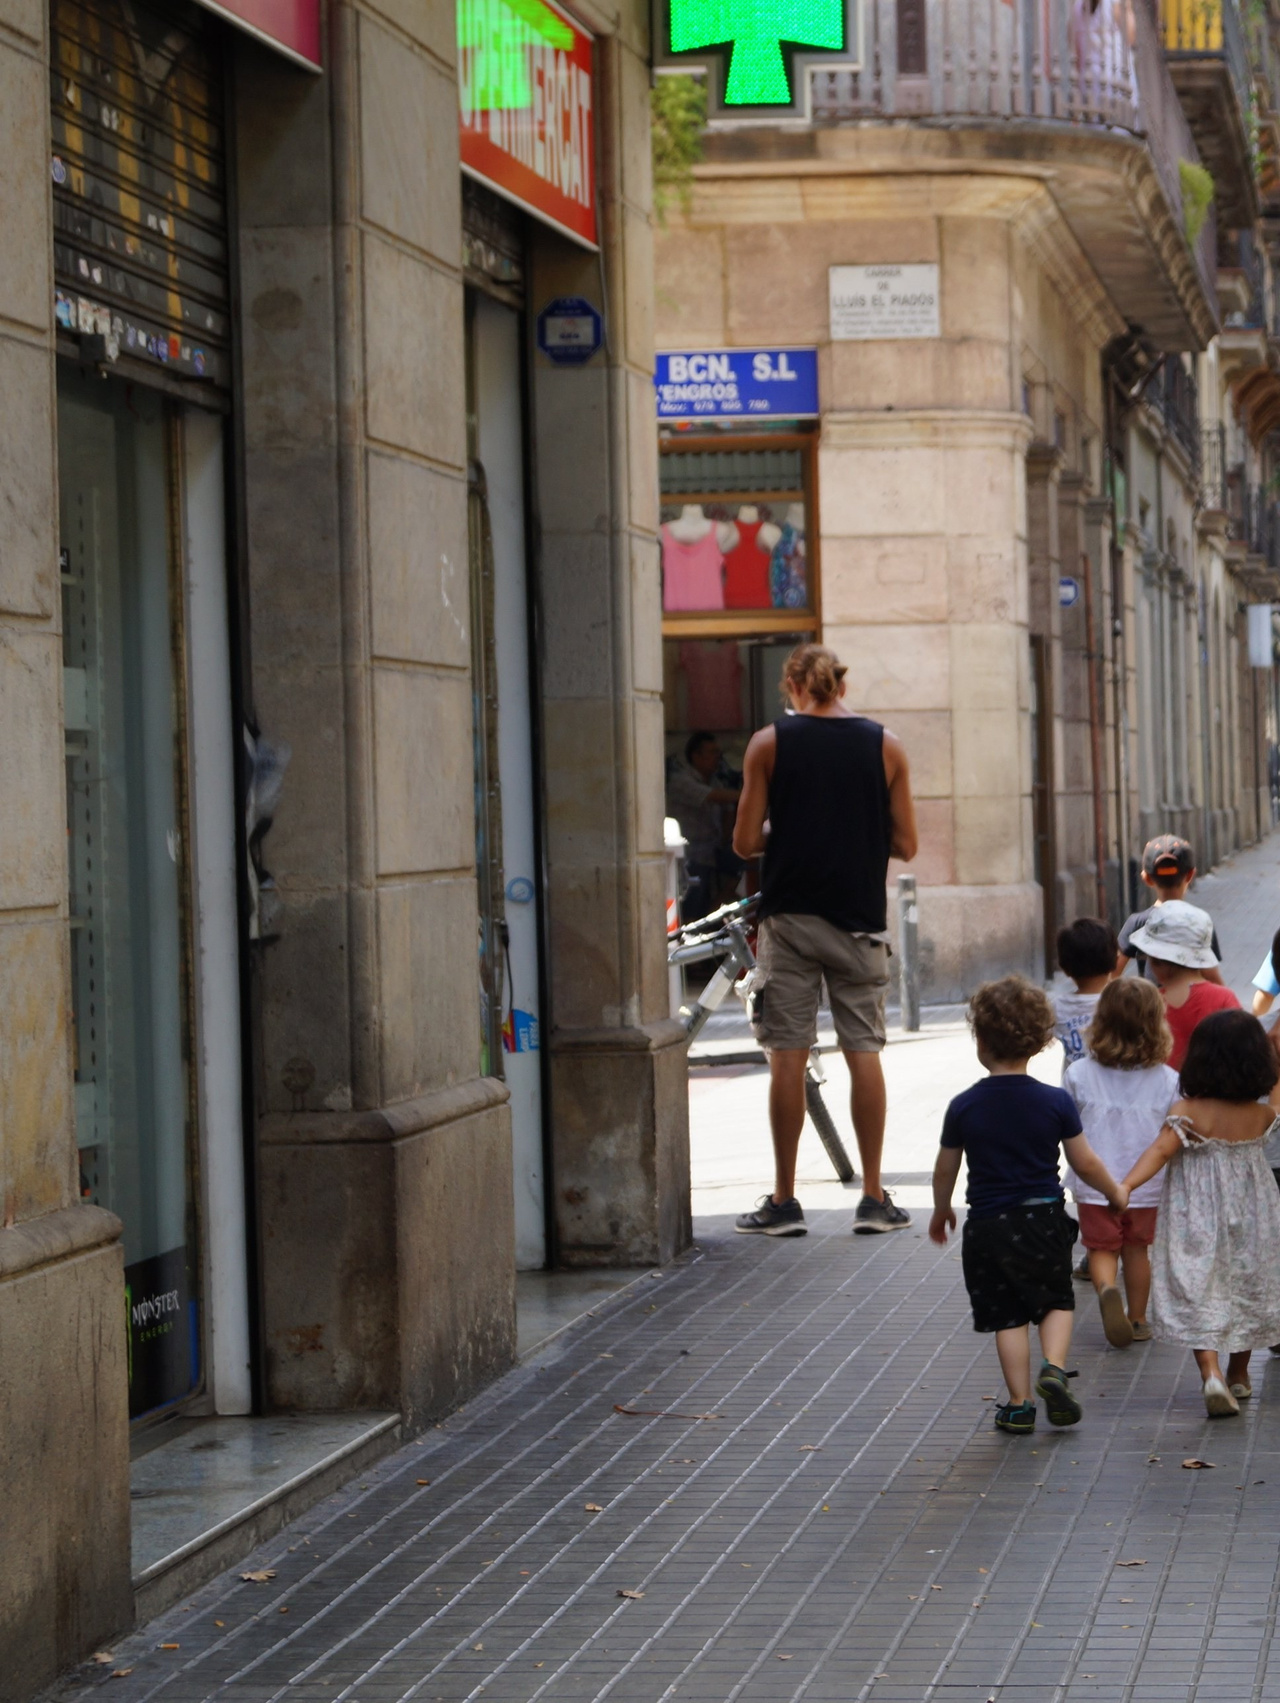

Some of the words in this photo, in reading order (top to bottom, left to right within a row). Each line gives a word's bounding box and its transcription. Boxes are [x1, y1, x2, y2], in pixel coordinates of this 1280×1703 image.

[871, 295, 885, 306] EL
[668, 354, 737, 383] BCN.
[752, 352, 797, 382] S.L
